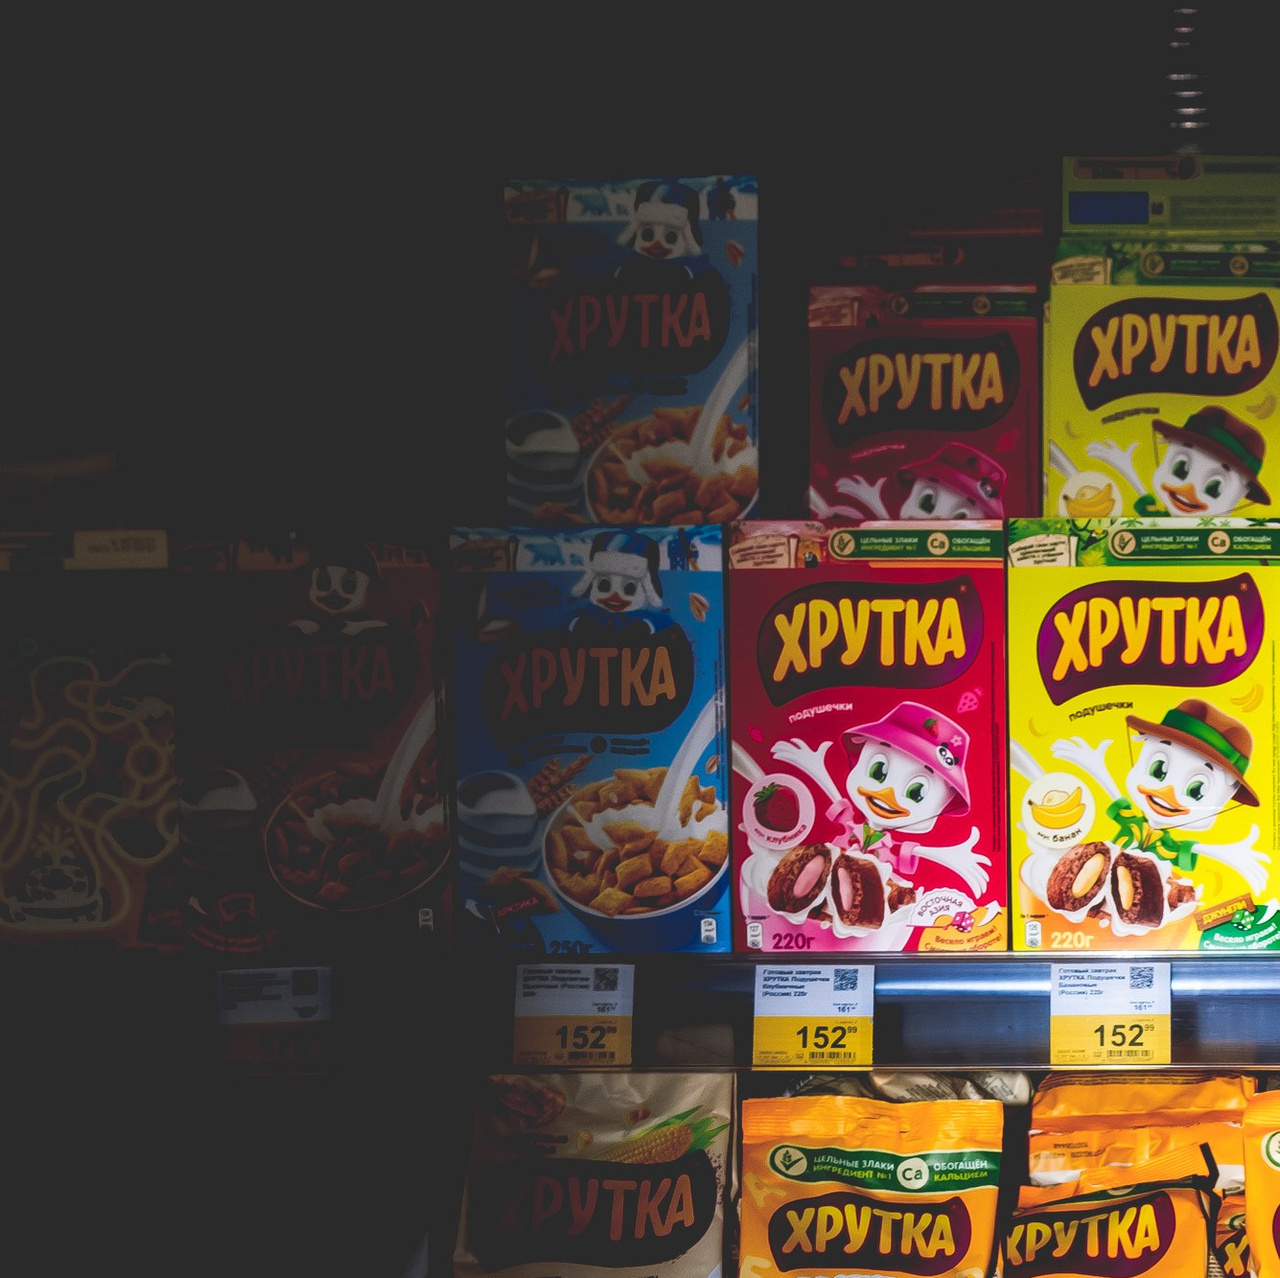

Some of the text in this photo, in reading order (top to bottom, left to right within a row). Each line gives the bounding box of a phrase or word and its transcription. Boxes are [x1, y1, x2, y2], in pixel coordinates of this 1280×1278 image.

[548, 290, 713, 364] ХРУТКА
[1088, 312, 1263, 389] ХРУТКА
[837, 351, 1006, 426] ХРУТКА
[773, 597, 966, 682] ХРУТКА
[1052, 595, 1247, 681] ХРУТКА
[500, 645, 677, 722] ХРУТКА
[788, 702, 853, 723] подушечки
[1068, 701, 1133, 722] подушечки
[1052, 828, 1082, 843] банан
[929, 905, 950, 917] АЗИЯ
[772, 933, 815, 950] 220г
[1051, 931, 1094, 948] 220г
[555, 1025, 606, 1049] 152
[796, 1026, 857, 1049] 152 99
[1094, 1024, 1154, 1047] 152 99
[813, 1155, 894, 1171] ЦЕЛЬНЫЕ ЗЛАКИ
[782, 1204, 955, 1258] ХРУТКА
